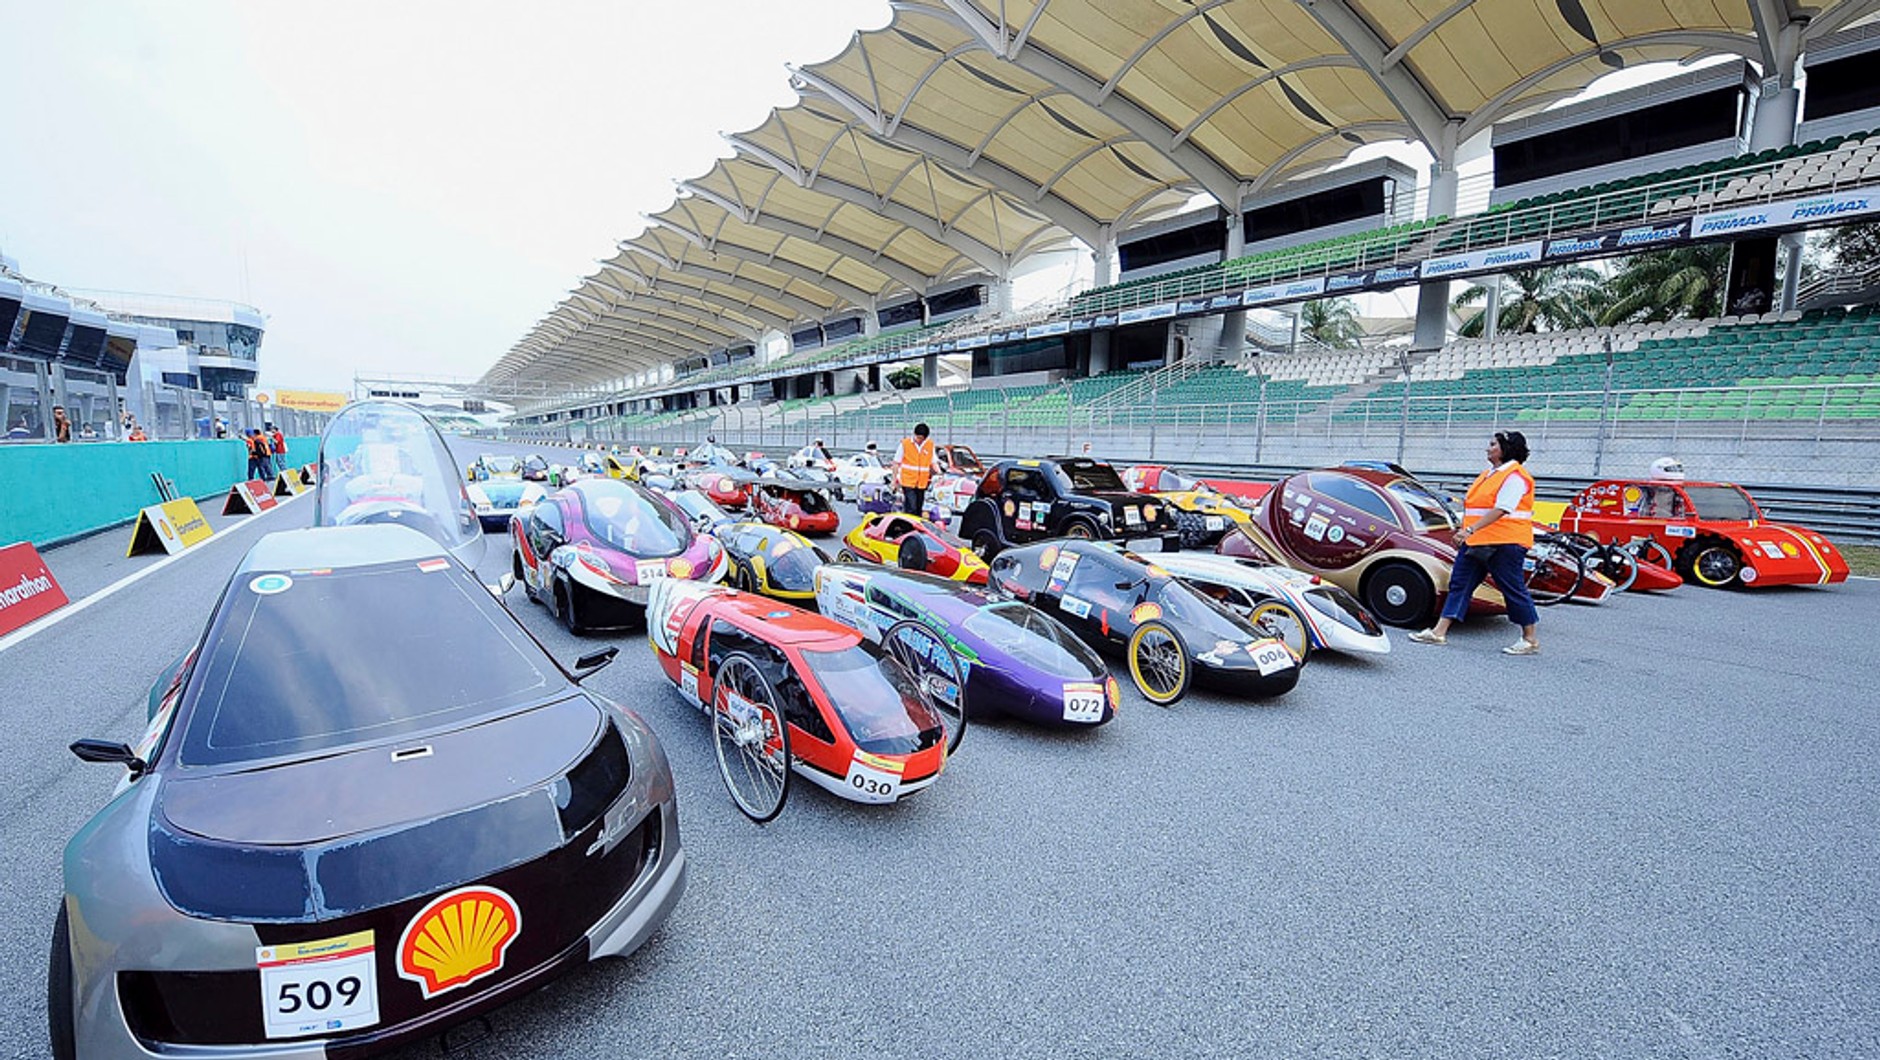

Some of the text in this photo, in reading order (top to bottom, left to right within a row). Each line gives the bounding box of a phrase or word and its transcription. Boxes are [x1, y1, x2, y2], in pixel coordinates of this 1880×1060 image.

[1791, 199, 1869, 220] PRIMAX
[1700, 214, 1768, 232] PRIMAX
[1618, 226, 1680, 246] PRIMAX
[1546, 237, 1603, 256] PRIMAX
[1426, 260, 1470, 274] PRIMAX
[1483, 250, 1532, 266] PRIMAX
[641, 568, 665, 579] 514
[1259, 648, 1287, 665] 006
[1070, 698, 1100, 713] 072
[852, 774, 892, 796] 030
[279, 976, 362, 1015] 509
